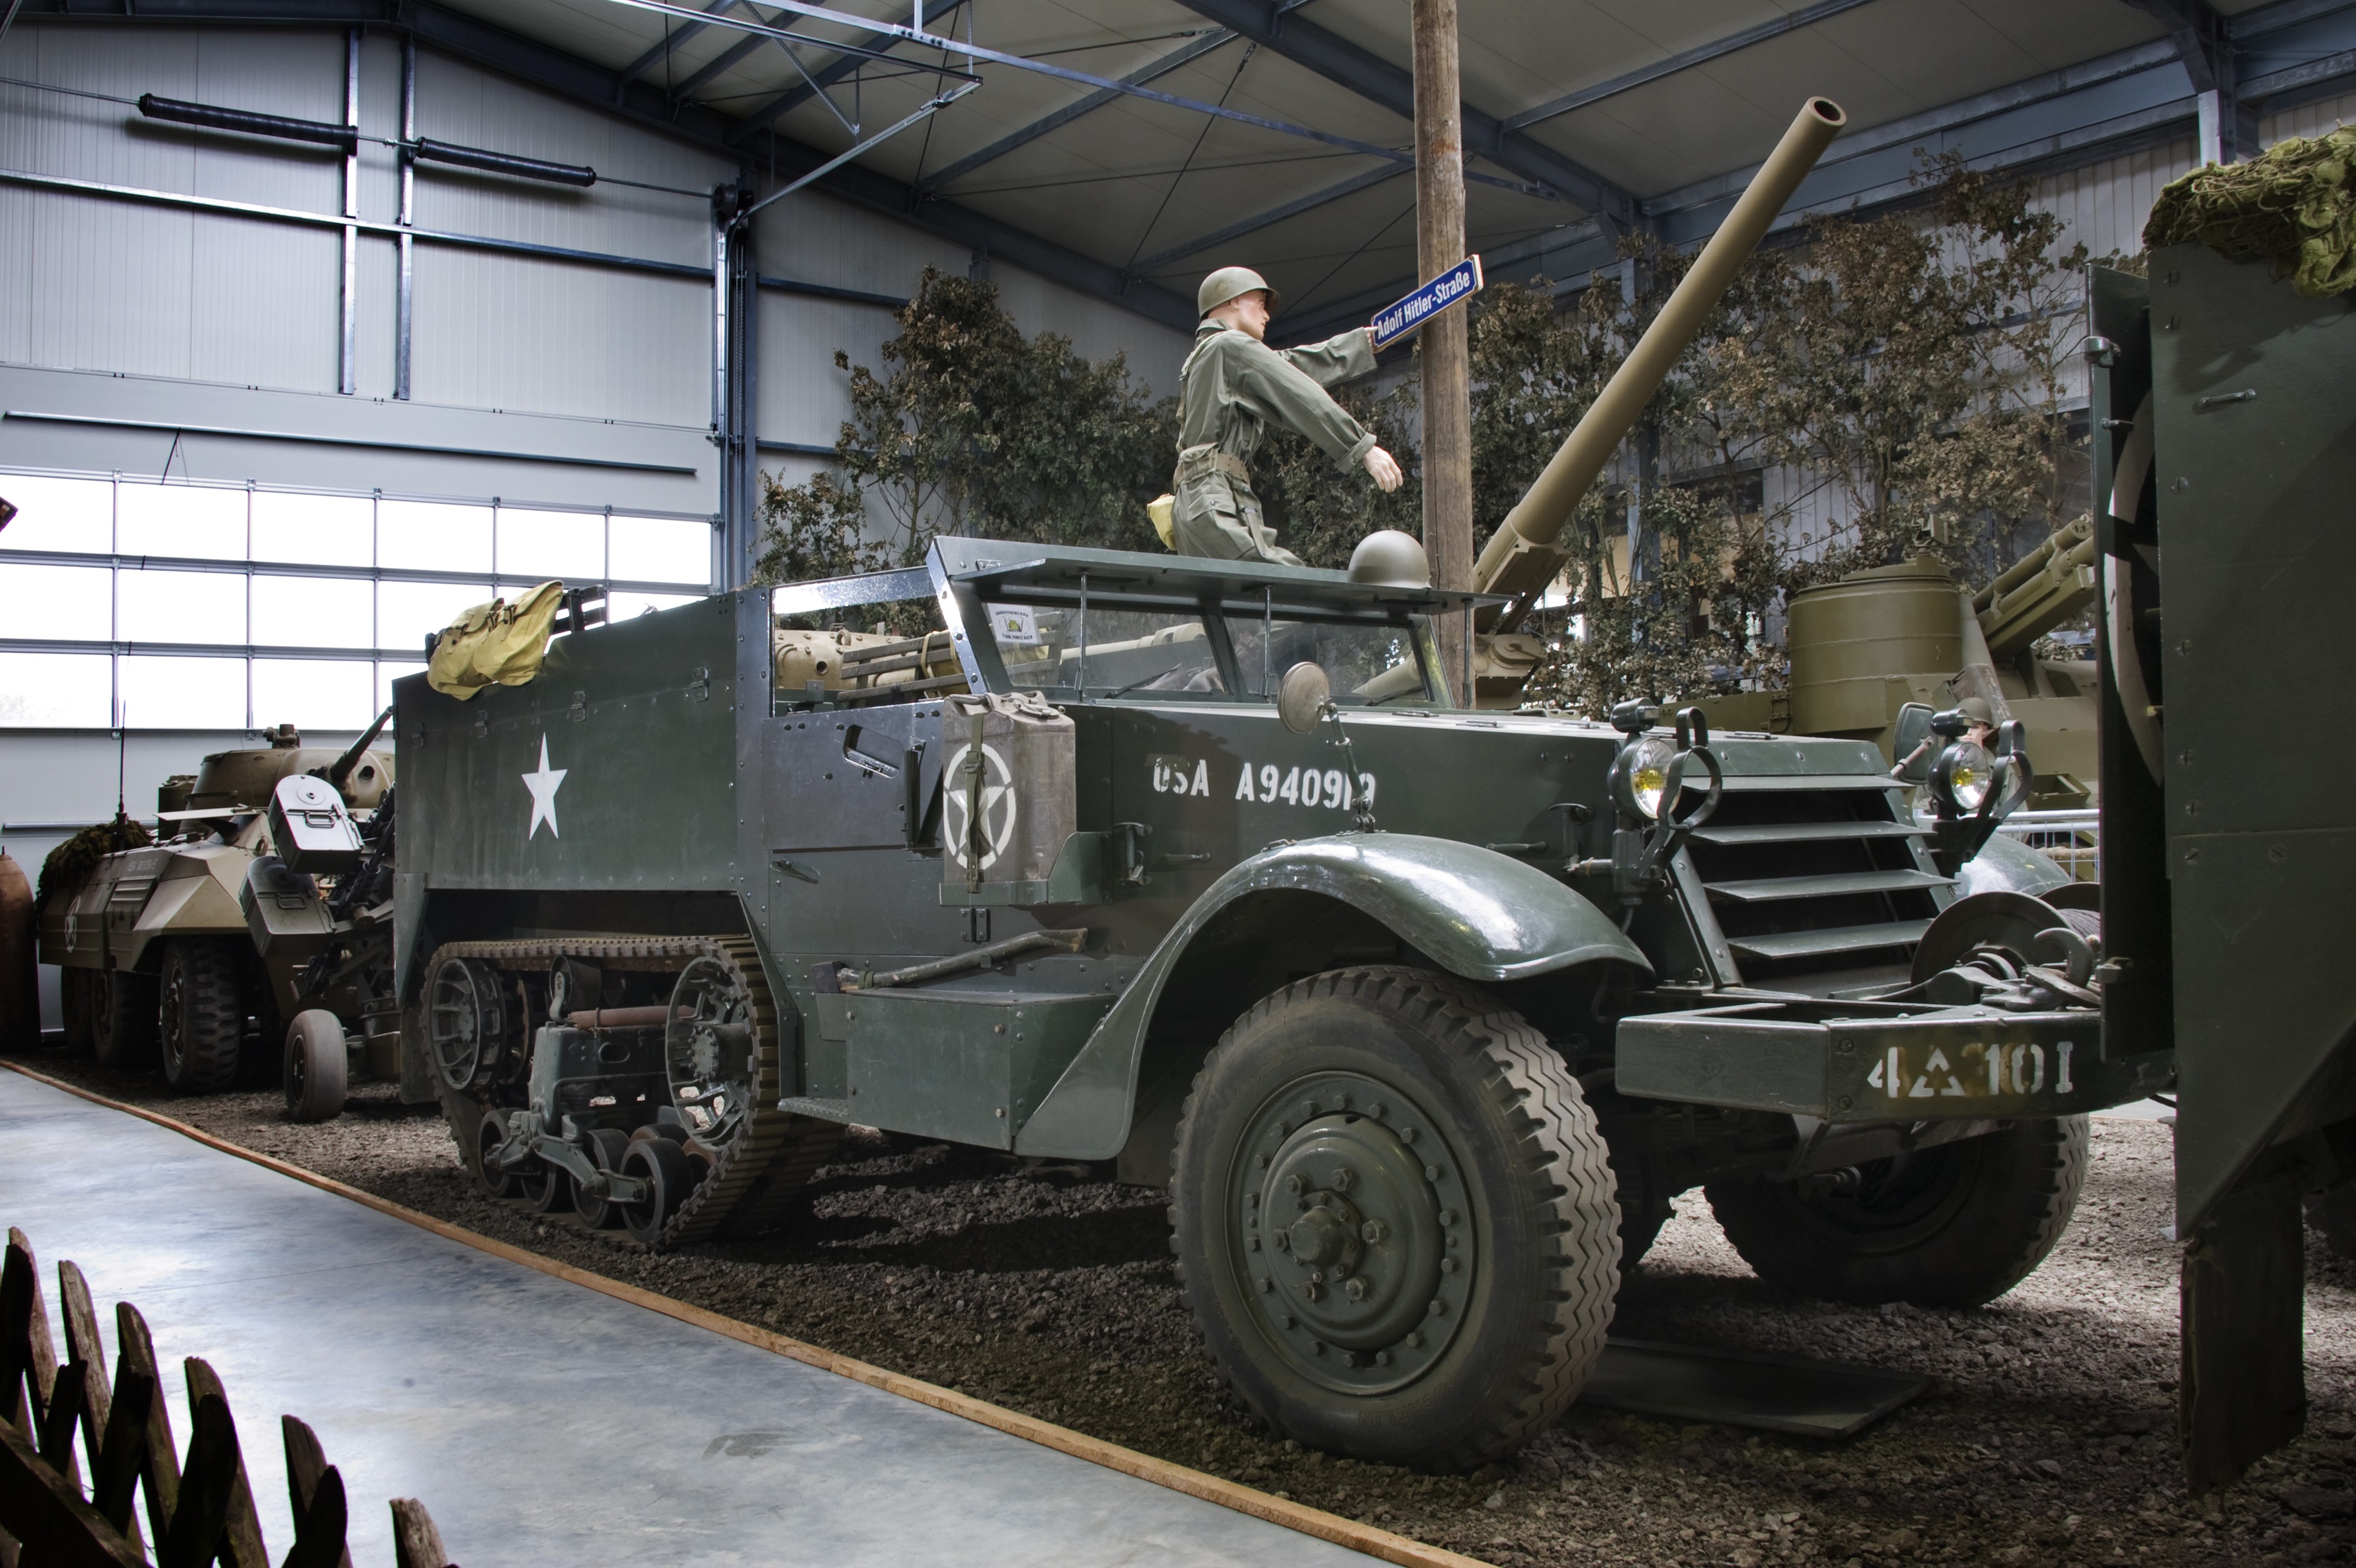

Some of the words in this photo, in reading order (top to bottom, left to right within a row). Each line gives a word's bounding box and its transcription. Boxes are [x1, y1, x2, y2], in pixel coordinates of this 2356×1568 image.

[1377, 307, 1403, 340] Adolf
[1404, 271, 1471, 323] Hitler-Straße
[1153, 757, 1210, 797] USA
